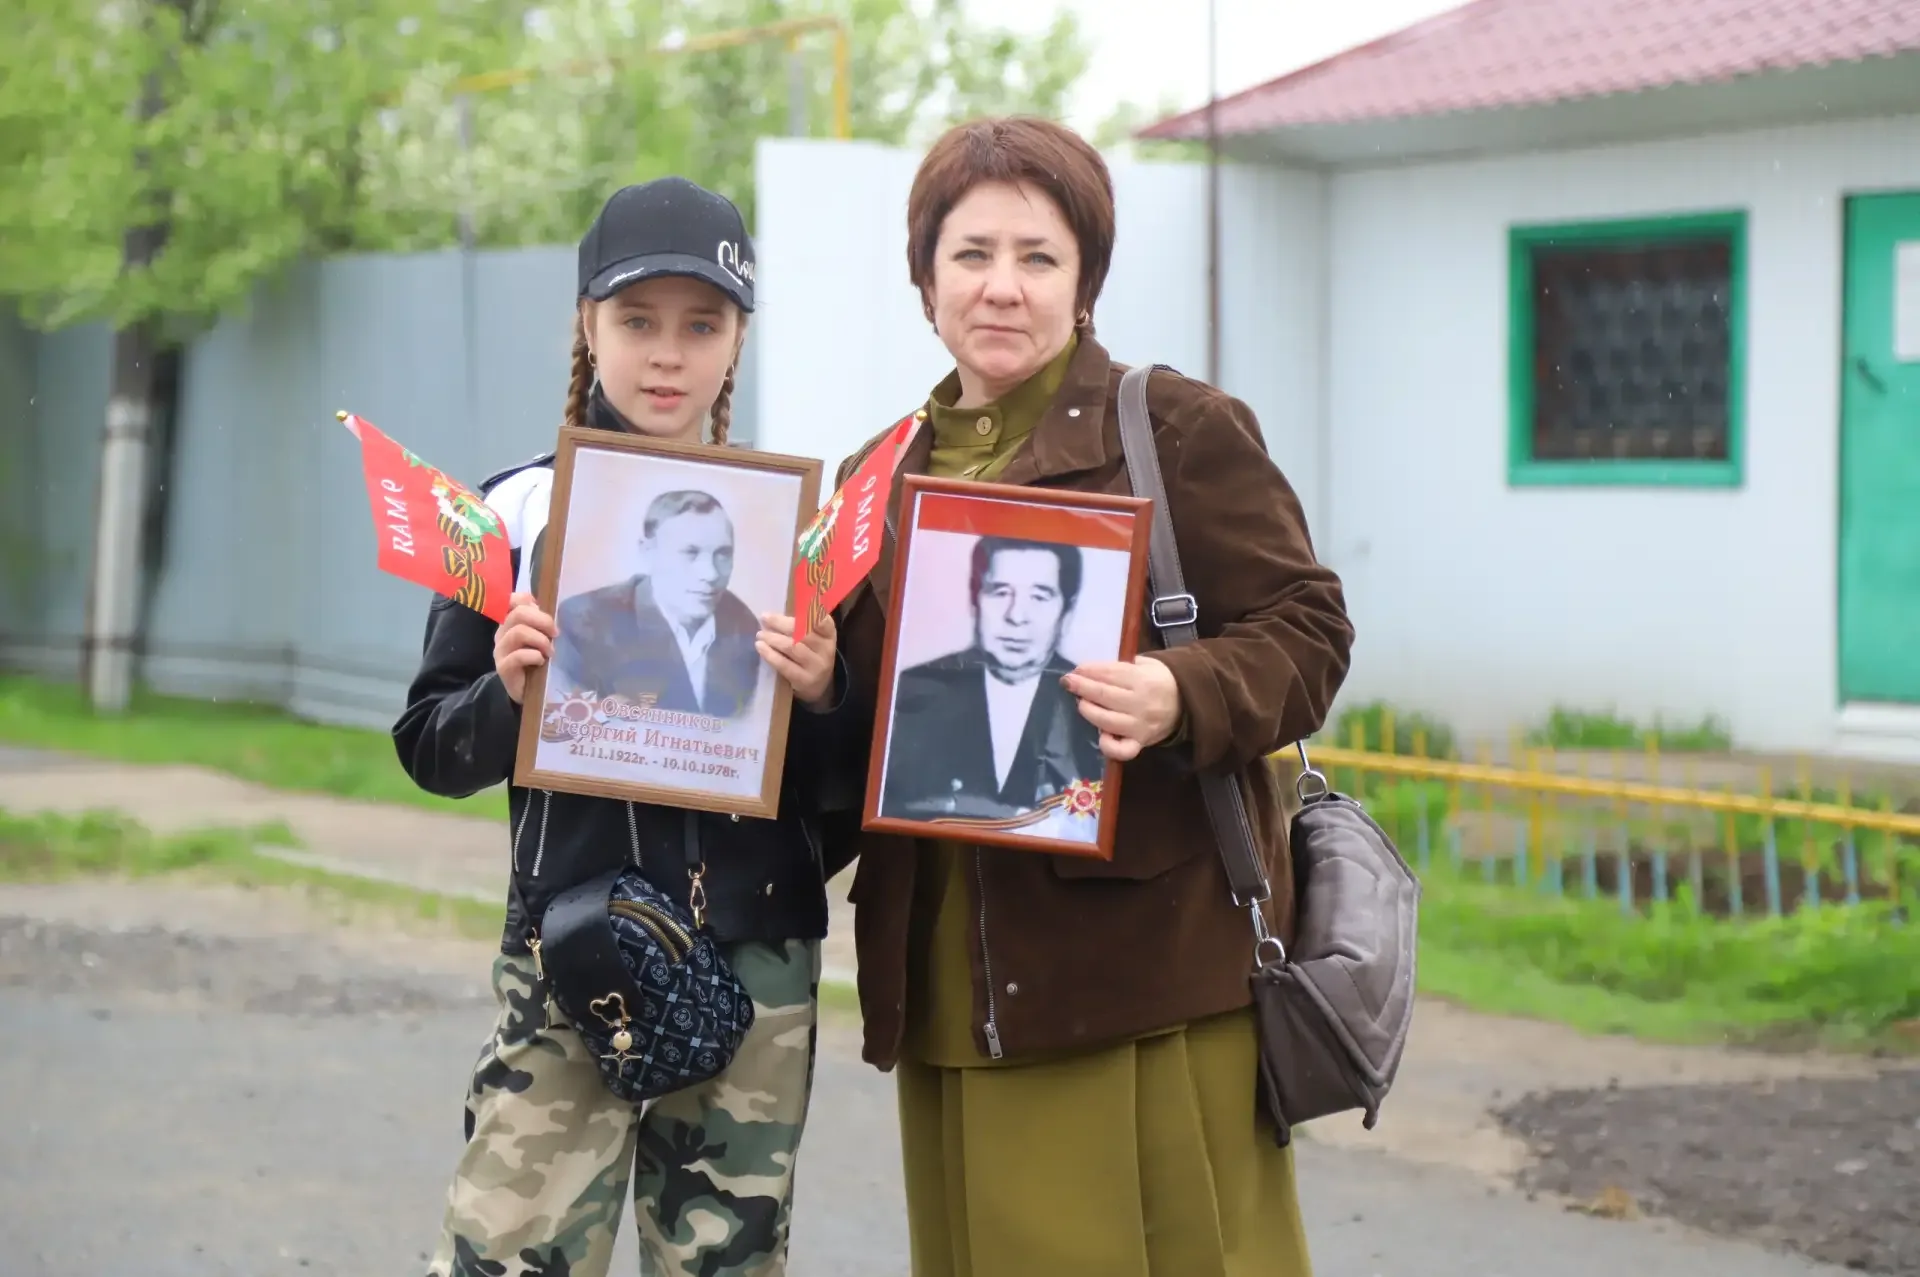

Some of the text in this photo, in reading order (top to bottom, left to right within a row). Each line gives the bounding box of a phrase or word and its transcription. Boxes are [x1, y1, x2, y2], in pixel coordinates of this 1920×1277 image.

[852, 475, 877, 562] 9 МАЯ
[601, 697, 722, 732] Овсянников
[556, 715, 760, 763] Георгий Игнатьевич
[569, 743, 649, 766] 21.11.1922г.
[662, 757, 740, 780] 10.10.1978г.
